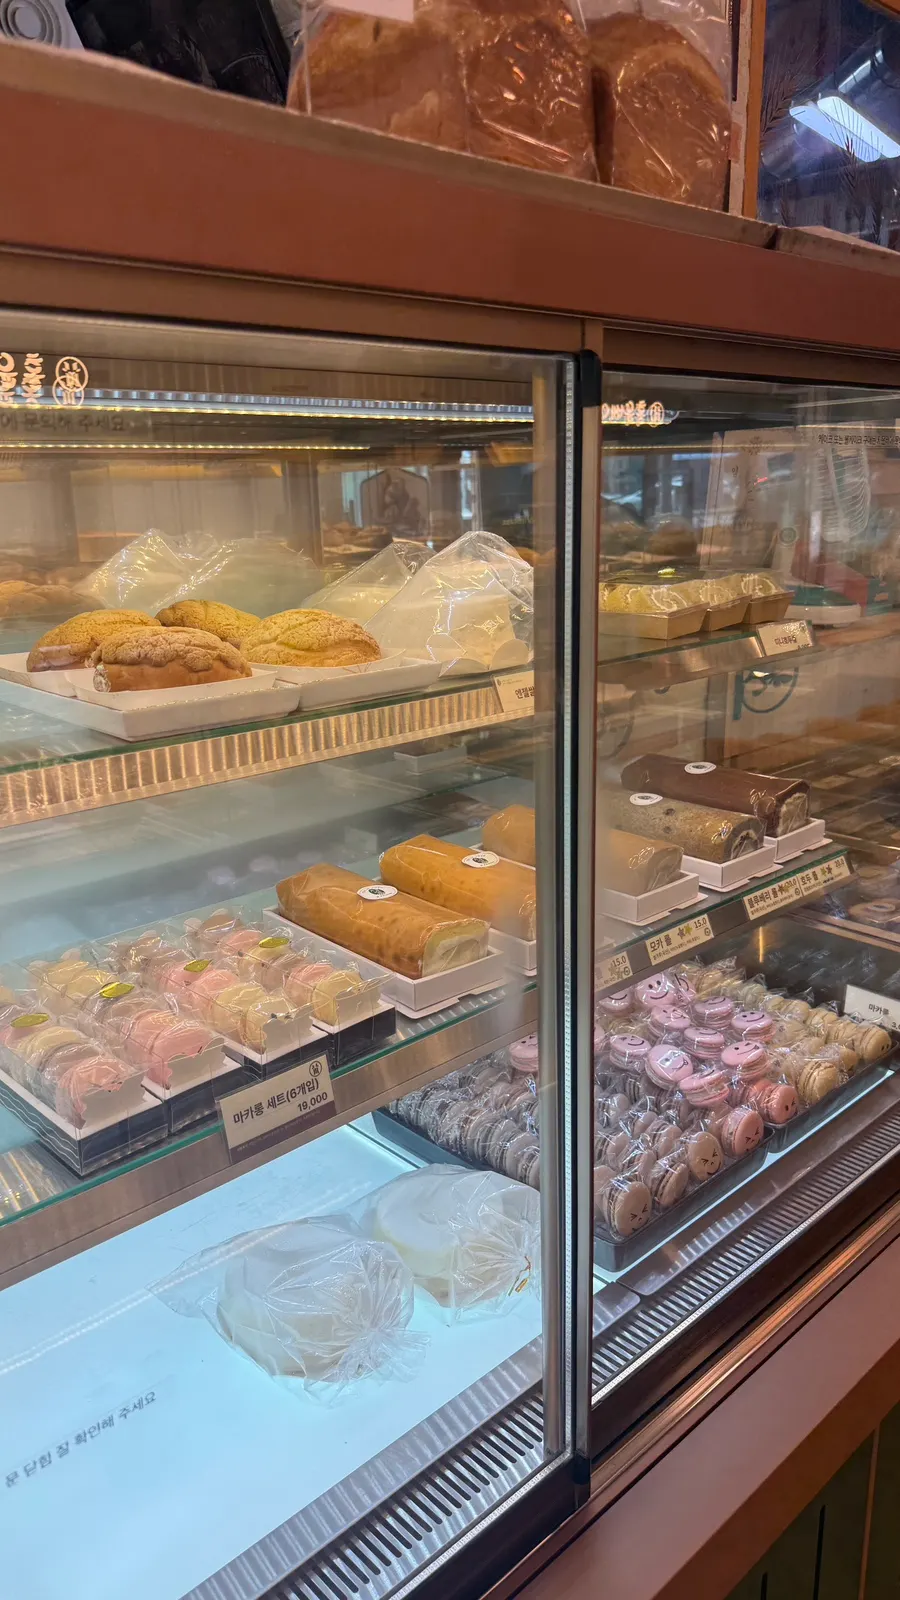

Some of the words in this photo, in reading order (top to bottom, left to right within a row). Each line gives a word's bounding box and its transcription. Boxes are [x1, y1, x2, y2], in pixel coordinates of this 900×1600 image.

[24, 411, 72, 432] 문의해
[78, 412, 125, 432] 주세요
[800, 875, 812, 886] 호두
[747, 891, 772, 909] 블루베리
[649, 937, 664, 952] 모카
[664, 934, 672, 947] 롤
[694, 917, 707, 929] 15.0
[612, 955, 627, 967] 15.0
[233, 1102, 265, 1124] 마카롱
[267, 1078, 319, 1110] 세트(6개입)
[297, 1091, 328, 1112] 19,000
[5, 1471, 19, 1487] 문
[23, 1451, 52, 1477] 닫힘
[74, 1414, 114, 1445] 확인해
[118, 1391, 156, 1420] 주세요
